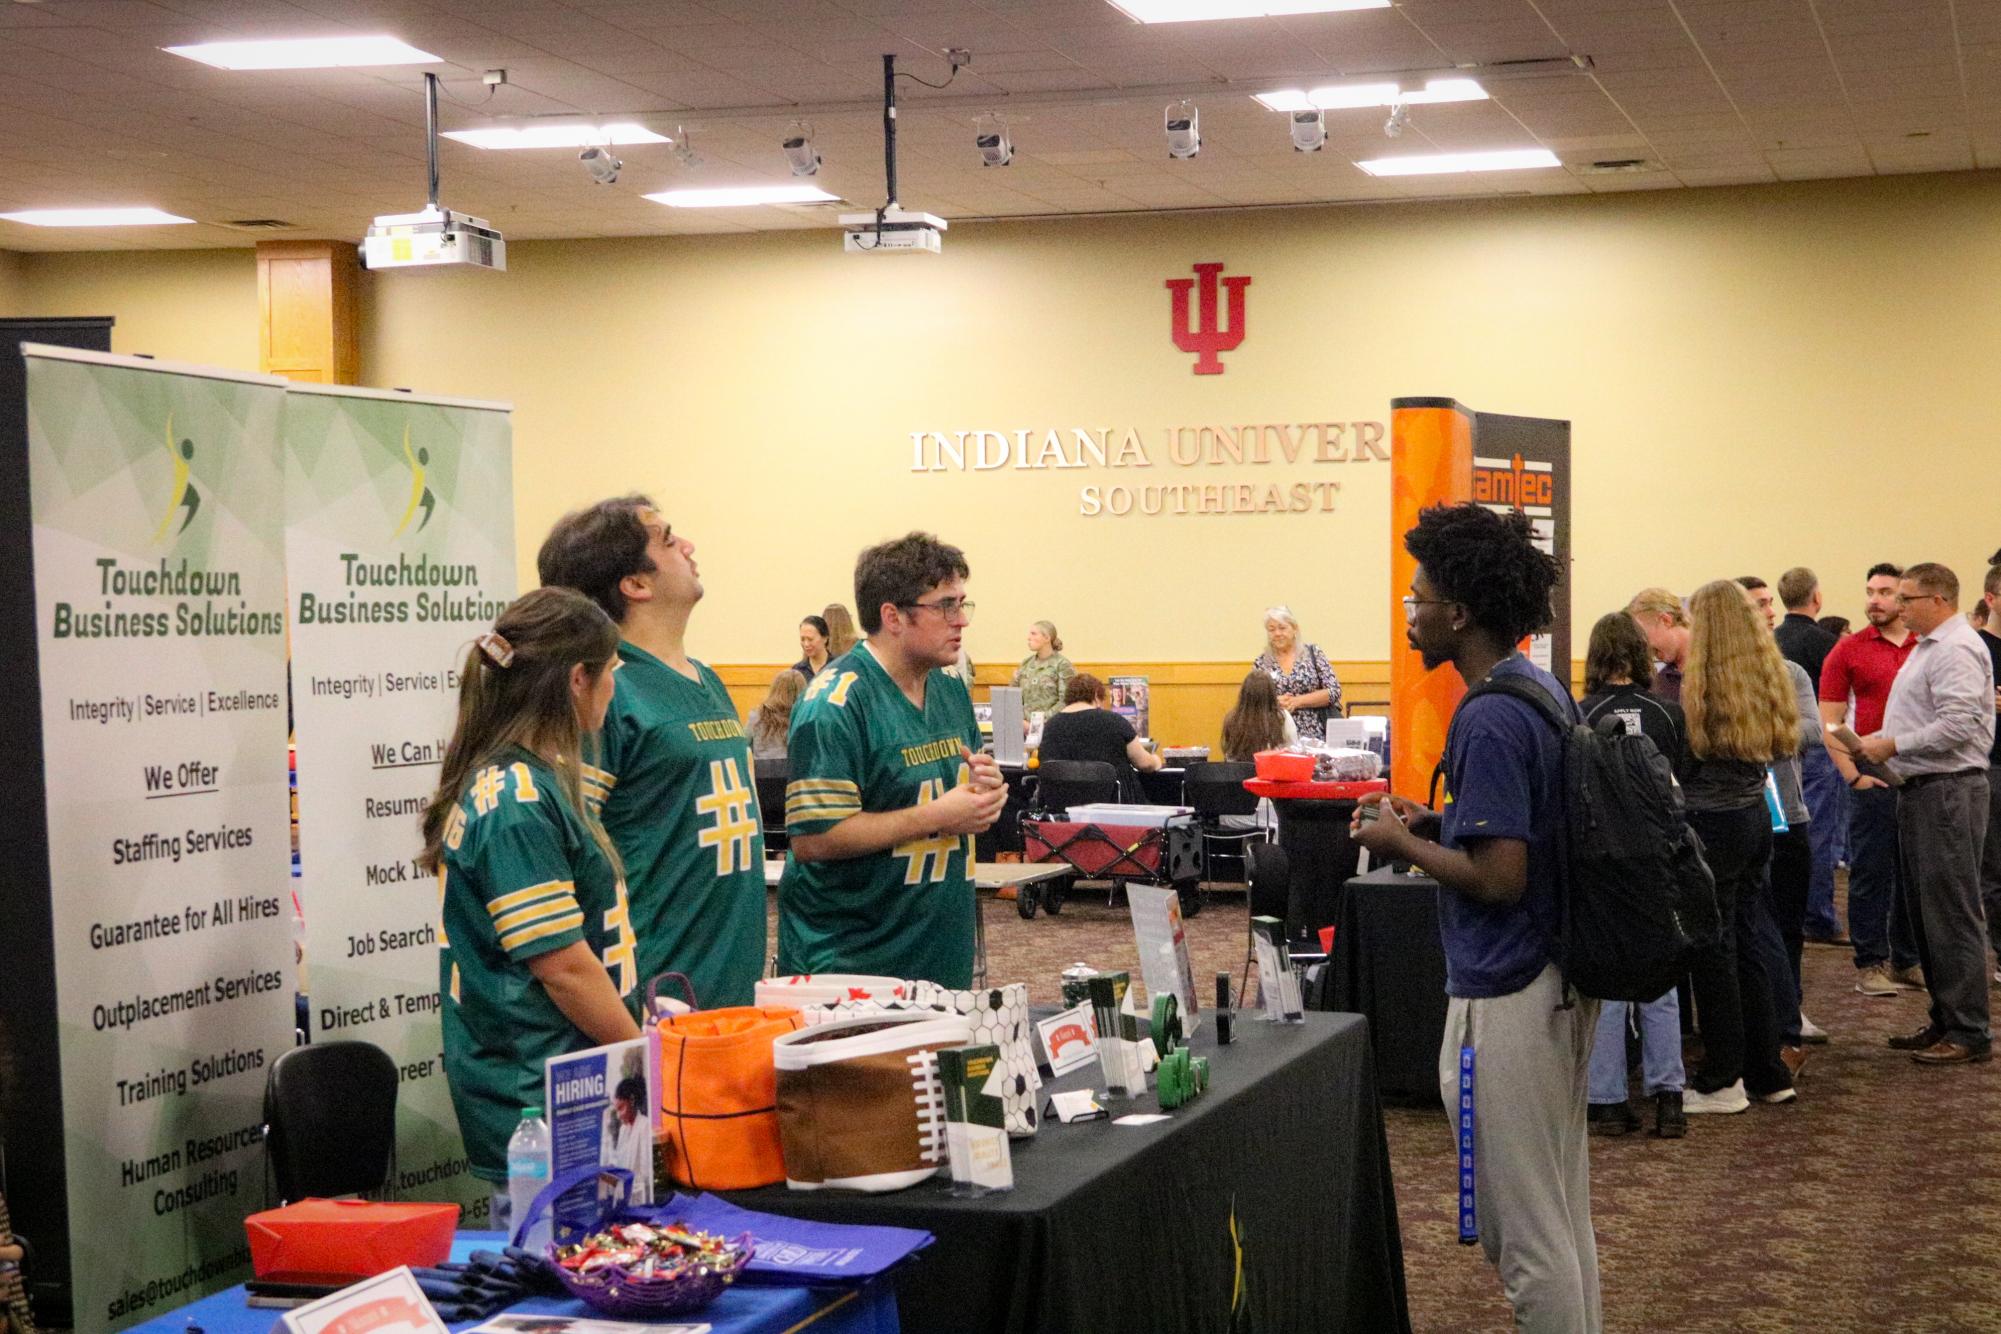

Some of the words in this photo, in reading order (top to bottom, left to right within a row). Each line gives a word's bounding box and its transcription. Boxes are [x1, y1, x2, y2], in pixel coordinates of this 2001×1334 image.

[909, 426, 1151, 472] INDIANA
[1166, 420, 1391, 466] UNIVER
[1079, 480, 1341, 517] SOUTHEAST
[96, 557, 241, 596] Touchdown
[340, 552, 478, 588] Touchdown
[53, 600, 169, 639] Business
[175, 600, 283, 636] Solutions
[299, 591, 409, 625] Business
[415, 590, 507, 624] Solution
[311, 671, 374, 699] Integrity
[385, 672, 438, 692] Service
[70, 695, 134, 724] Integrity
[145, 693, 196, 717] Service
[207, 689, 279, 712] Excellence
[371, 744, 396, 765] We
[401, 742, 433, 762] Can
[145, 766, 173, 791] We
[177, 762, 219, 787] Offer
[470, 761, 540, 817] #1
[365, 796, 429, 819] Resume
[113, 831, 181, 865] Staffing
[185, 825, 253, 855] Services
[366, 860, 407, 886] Mock
[90, 912, 181, 950] Guarantee
[185, 904, 207, 931] for
[211, 899, 233, 925] All
[238, 896, 280, 922] Hires
[347, 928, 375, 958] Job
[379, 923, 434, 952] Search
[92, 980, 211, 1033] Outplacement
[214, 969, 282, 1003] Services
[320, 999, 376, 1031] Direct
[378, 998, 391, 1019] &
[394, 991, 441, 1021] Temp
[116, 1065, 187, 1106] Training
[191, 1047, 264, 1086] Solutions
[400, 1058, 435, 1082] reer
[555, 1073, 604, 1105] HIRING
[121, 1150, 180, 1187] Human
[153, 1167, 238, 1218] Consulting
